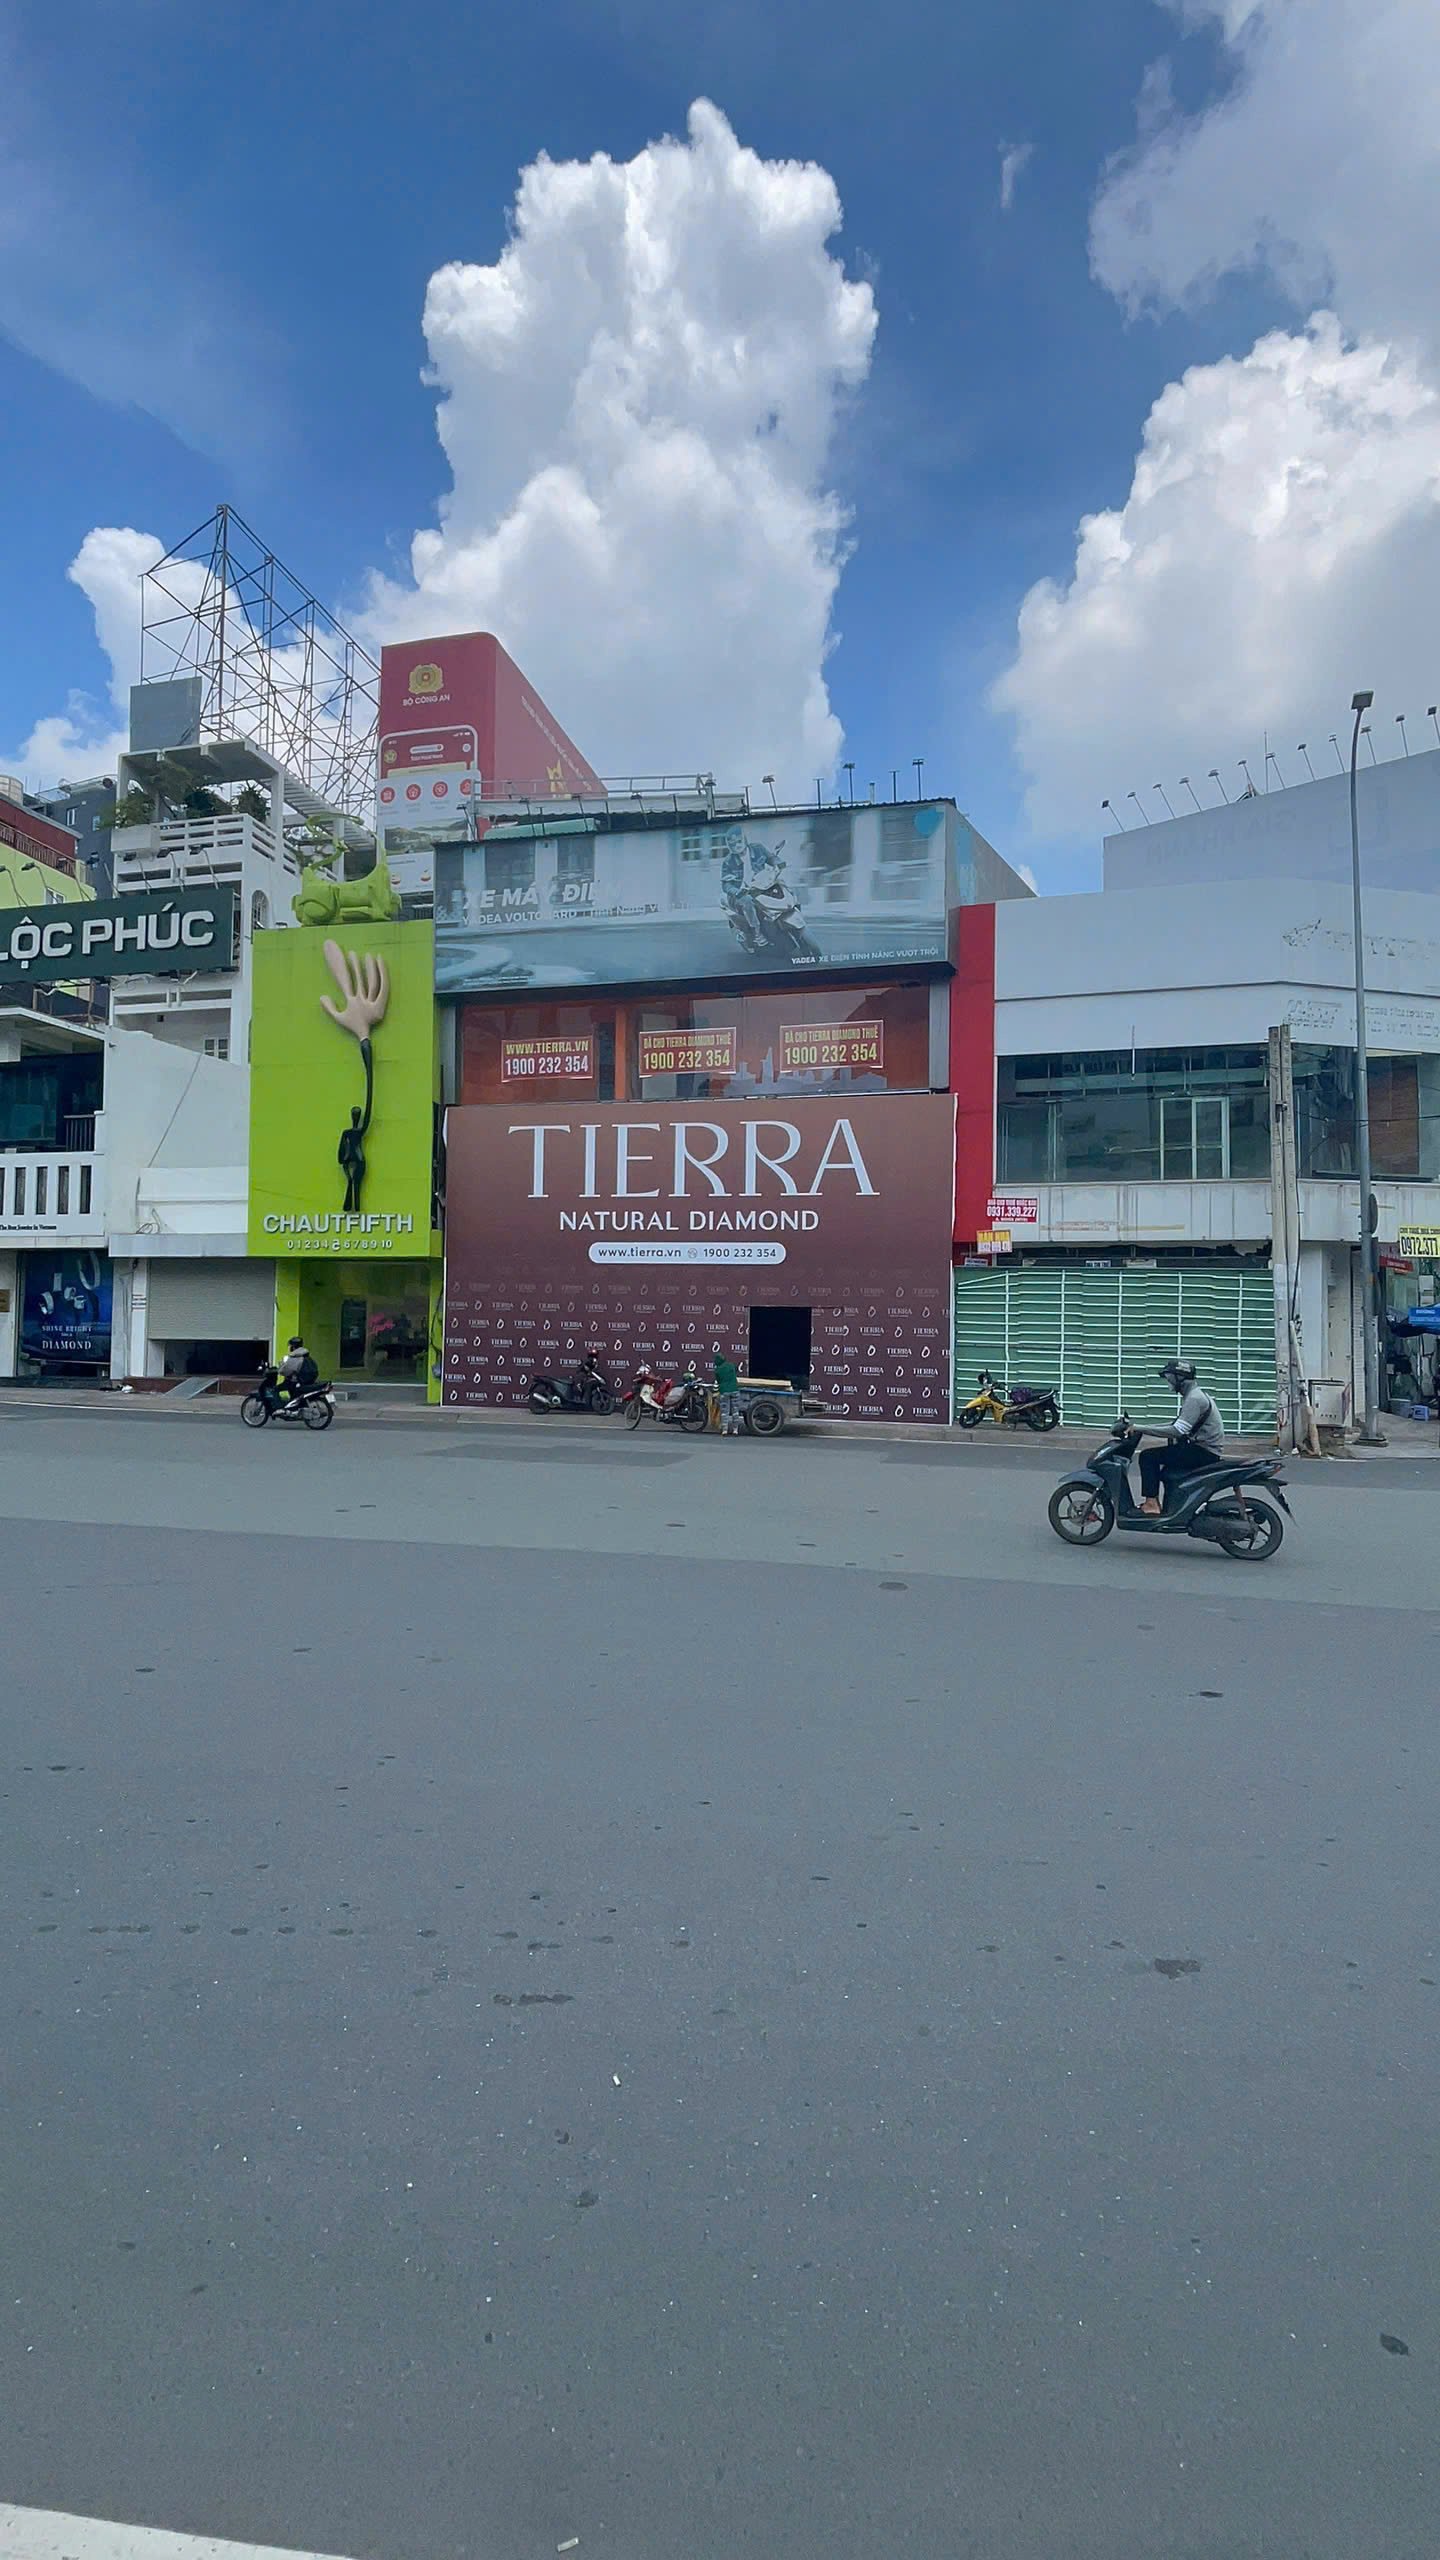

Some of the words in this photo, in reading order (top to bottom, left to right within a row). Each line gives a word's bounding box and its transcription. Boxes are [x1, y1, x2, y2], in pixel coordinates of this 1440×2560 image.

[439, 694, 450, 702] AN
[0, 916, 72, 968] ỘC
[82, 902, 214, 954] PHÚC
[792, 956, 816, 964] YADEA
[666, 1037, 686, 1047] TIERRA
[808, 1030, 830, 1042] TIERRA
[506, 1040, 589, 1055] WWW.TIERRA.VN
[785, 1046, 817, 1065] 1900
[822, 1044, 847, 1062] 232
[852, 1043, 877, 1061] 354
[505, 1057, 534, 1076] 1900
[538, 1056, 562, 1075] 232
[565, 1055, 589, 1073] 354
[644, 1052, 673, 1070] 1900
[678, 1051, 701, 1069] 232
[706, 1050, 730, 1066] 354
[508, 1118, 880, 1198] TIERRA
[263, 1214, 413, 1233] CHAUTFIFTH
[559, 1210, 679, 1231] NATURAL
[689, 1210, 819, 1231] DIAMOND
[598, 1247, 681, 1258] www.tierra.vn
[703, 1248, 730, 1258] 1900
[734, 1248, 753, 1258] 232
[756, 1247, 776, 1258] 354
[42, 1340, 91, 1350] DIAMOND
